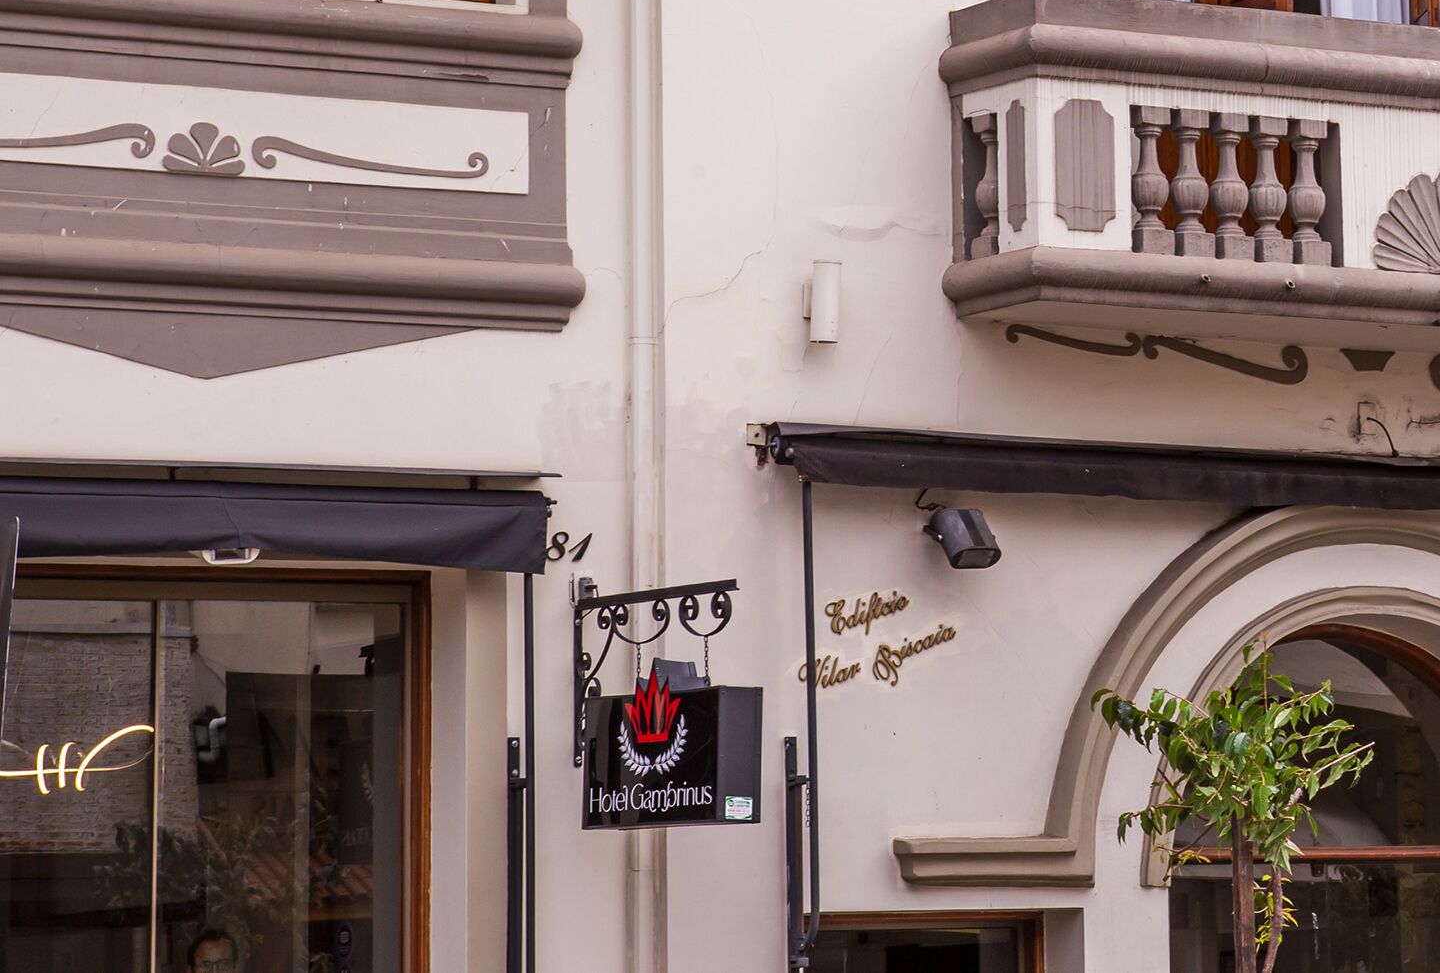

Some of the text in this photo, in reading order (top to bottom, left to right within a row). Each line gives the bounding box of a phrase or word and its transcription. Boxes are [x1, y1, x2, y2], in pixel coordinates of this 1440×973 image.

[546, 531, 593, 562] 81
[798, 623, 957, 689] Vilar Biscaia
[589, 784, 629, 814] Hotel
[630, 780, 713, 813] Gambrinus
